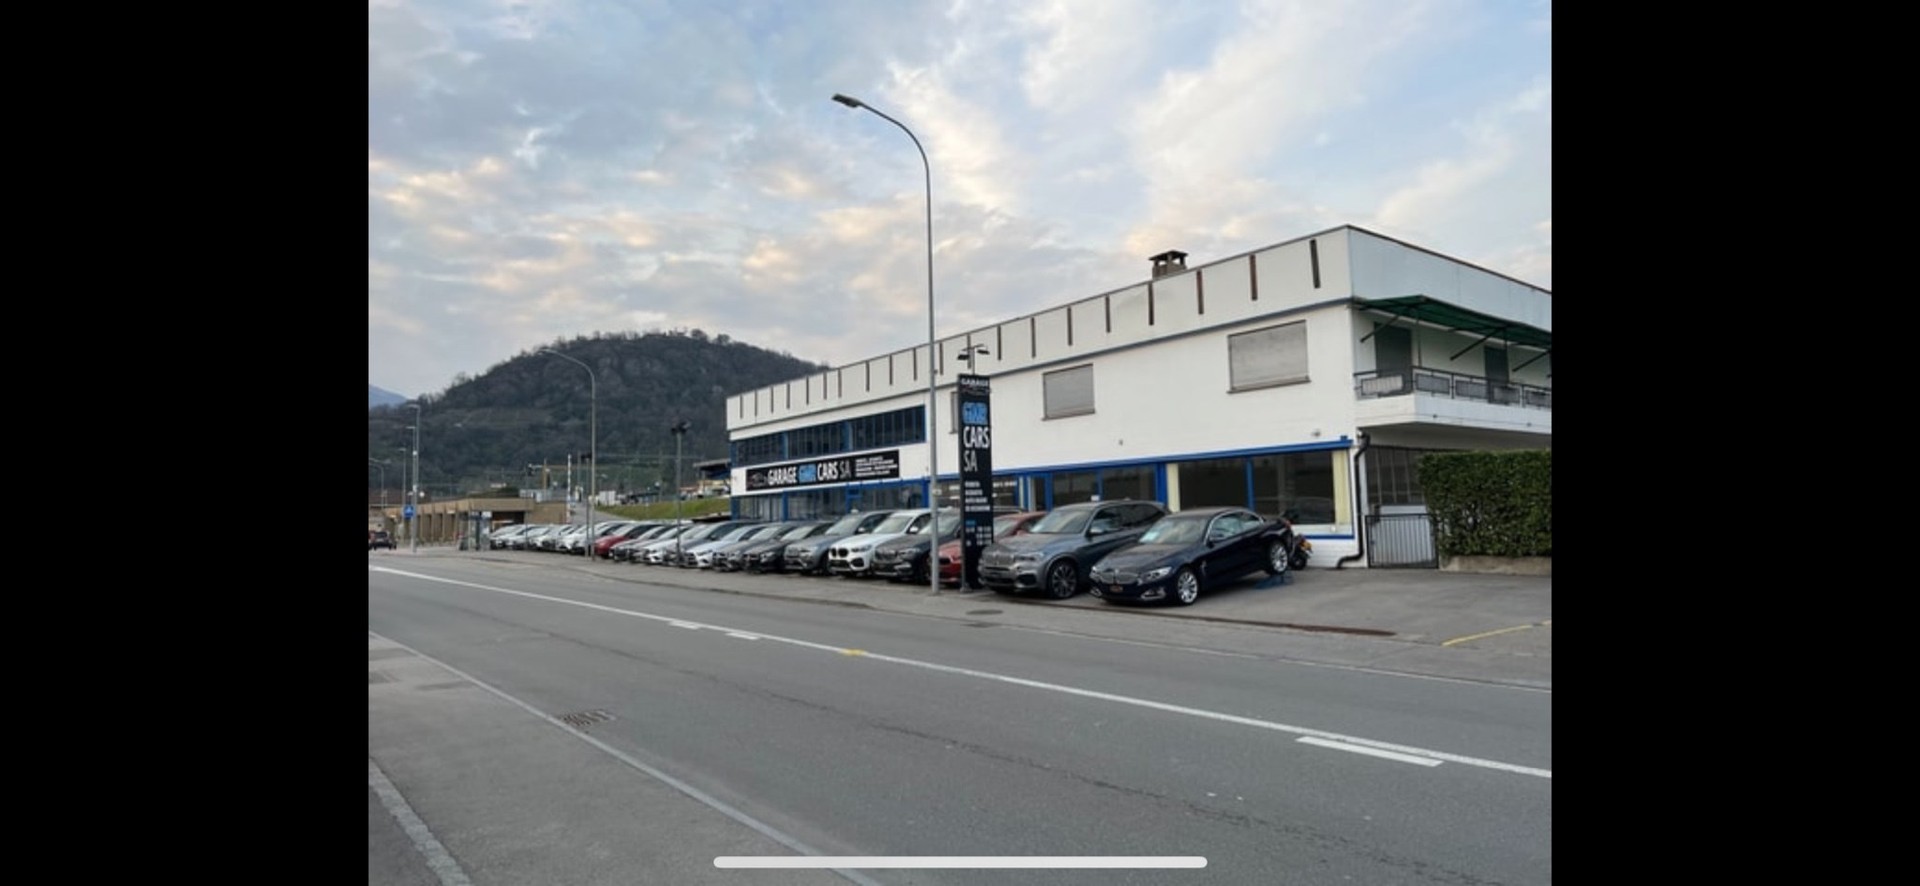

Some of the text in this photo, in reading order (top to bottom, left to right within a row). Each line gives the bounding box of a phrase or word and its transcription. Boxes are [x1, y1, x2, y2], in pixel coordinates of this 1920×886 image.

[963, 426, 990, 449] CARS
[963, 450, 978, 472] SA
[768, 466, 797, 486] GARAGE
[817, 461, 839, 482] CARS
[839, 460, 852, 479] SA
